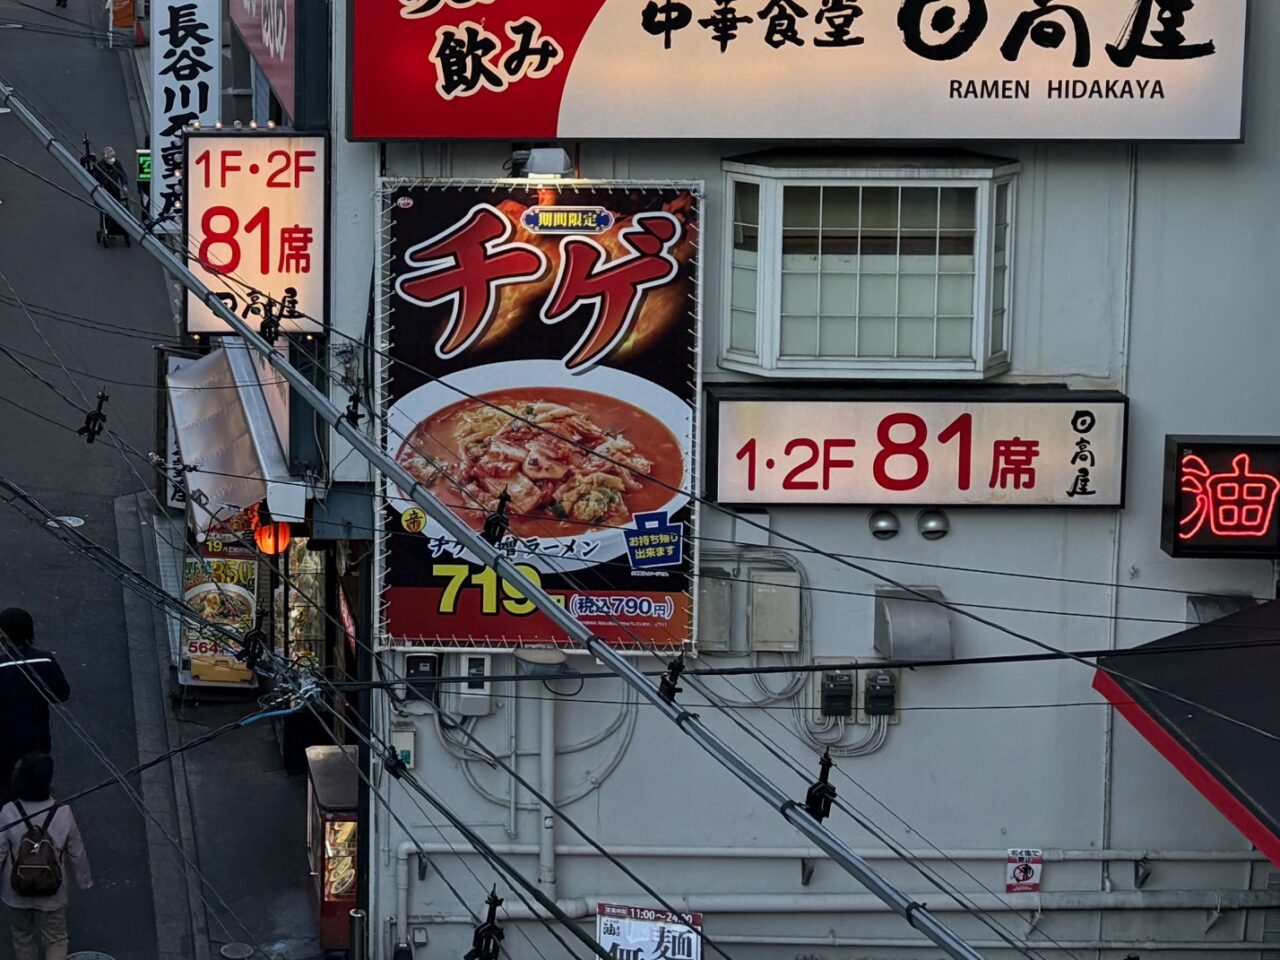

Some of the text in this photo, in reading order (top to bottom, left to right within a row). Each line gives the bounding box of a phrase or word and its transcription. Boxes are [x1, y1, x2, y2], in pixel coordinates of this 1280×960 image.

[428, 16, 564, 101] 飲み
[949, 78, 1166, 100] RAMEN HIDAKAYA
[199, 205, 314, 276] 81席
[538, 211, 598, 228] 期間限定
[396, 202, 683, 371] チゲ
[872, 412, 1040, 492] 81席
[1066, 409, 1096, 498] 日高屋
[1179, 453, 1280, 540] 油
[634, 546, 675, 560] 出来ます
[570, 594, 674, 619] (税込790円)
